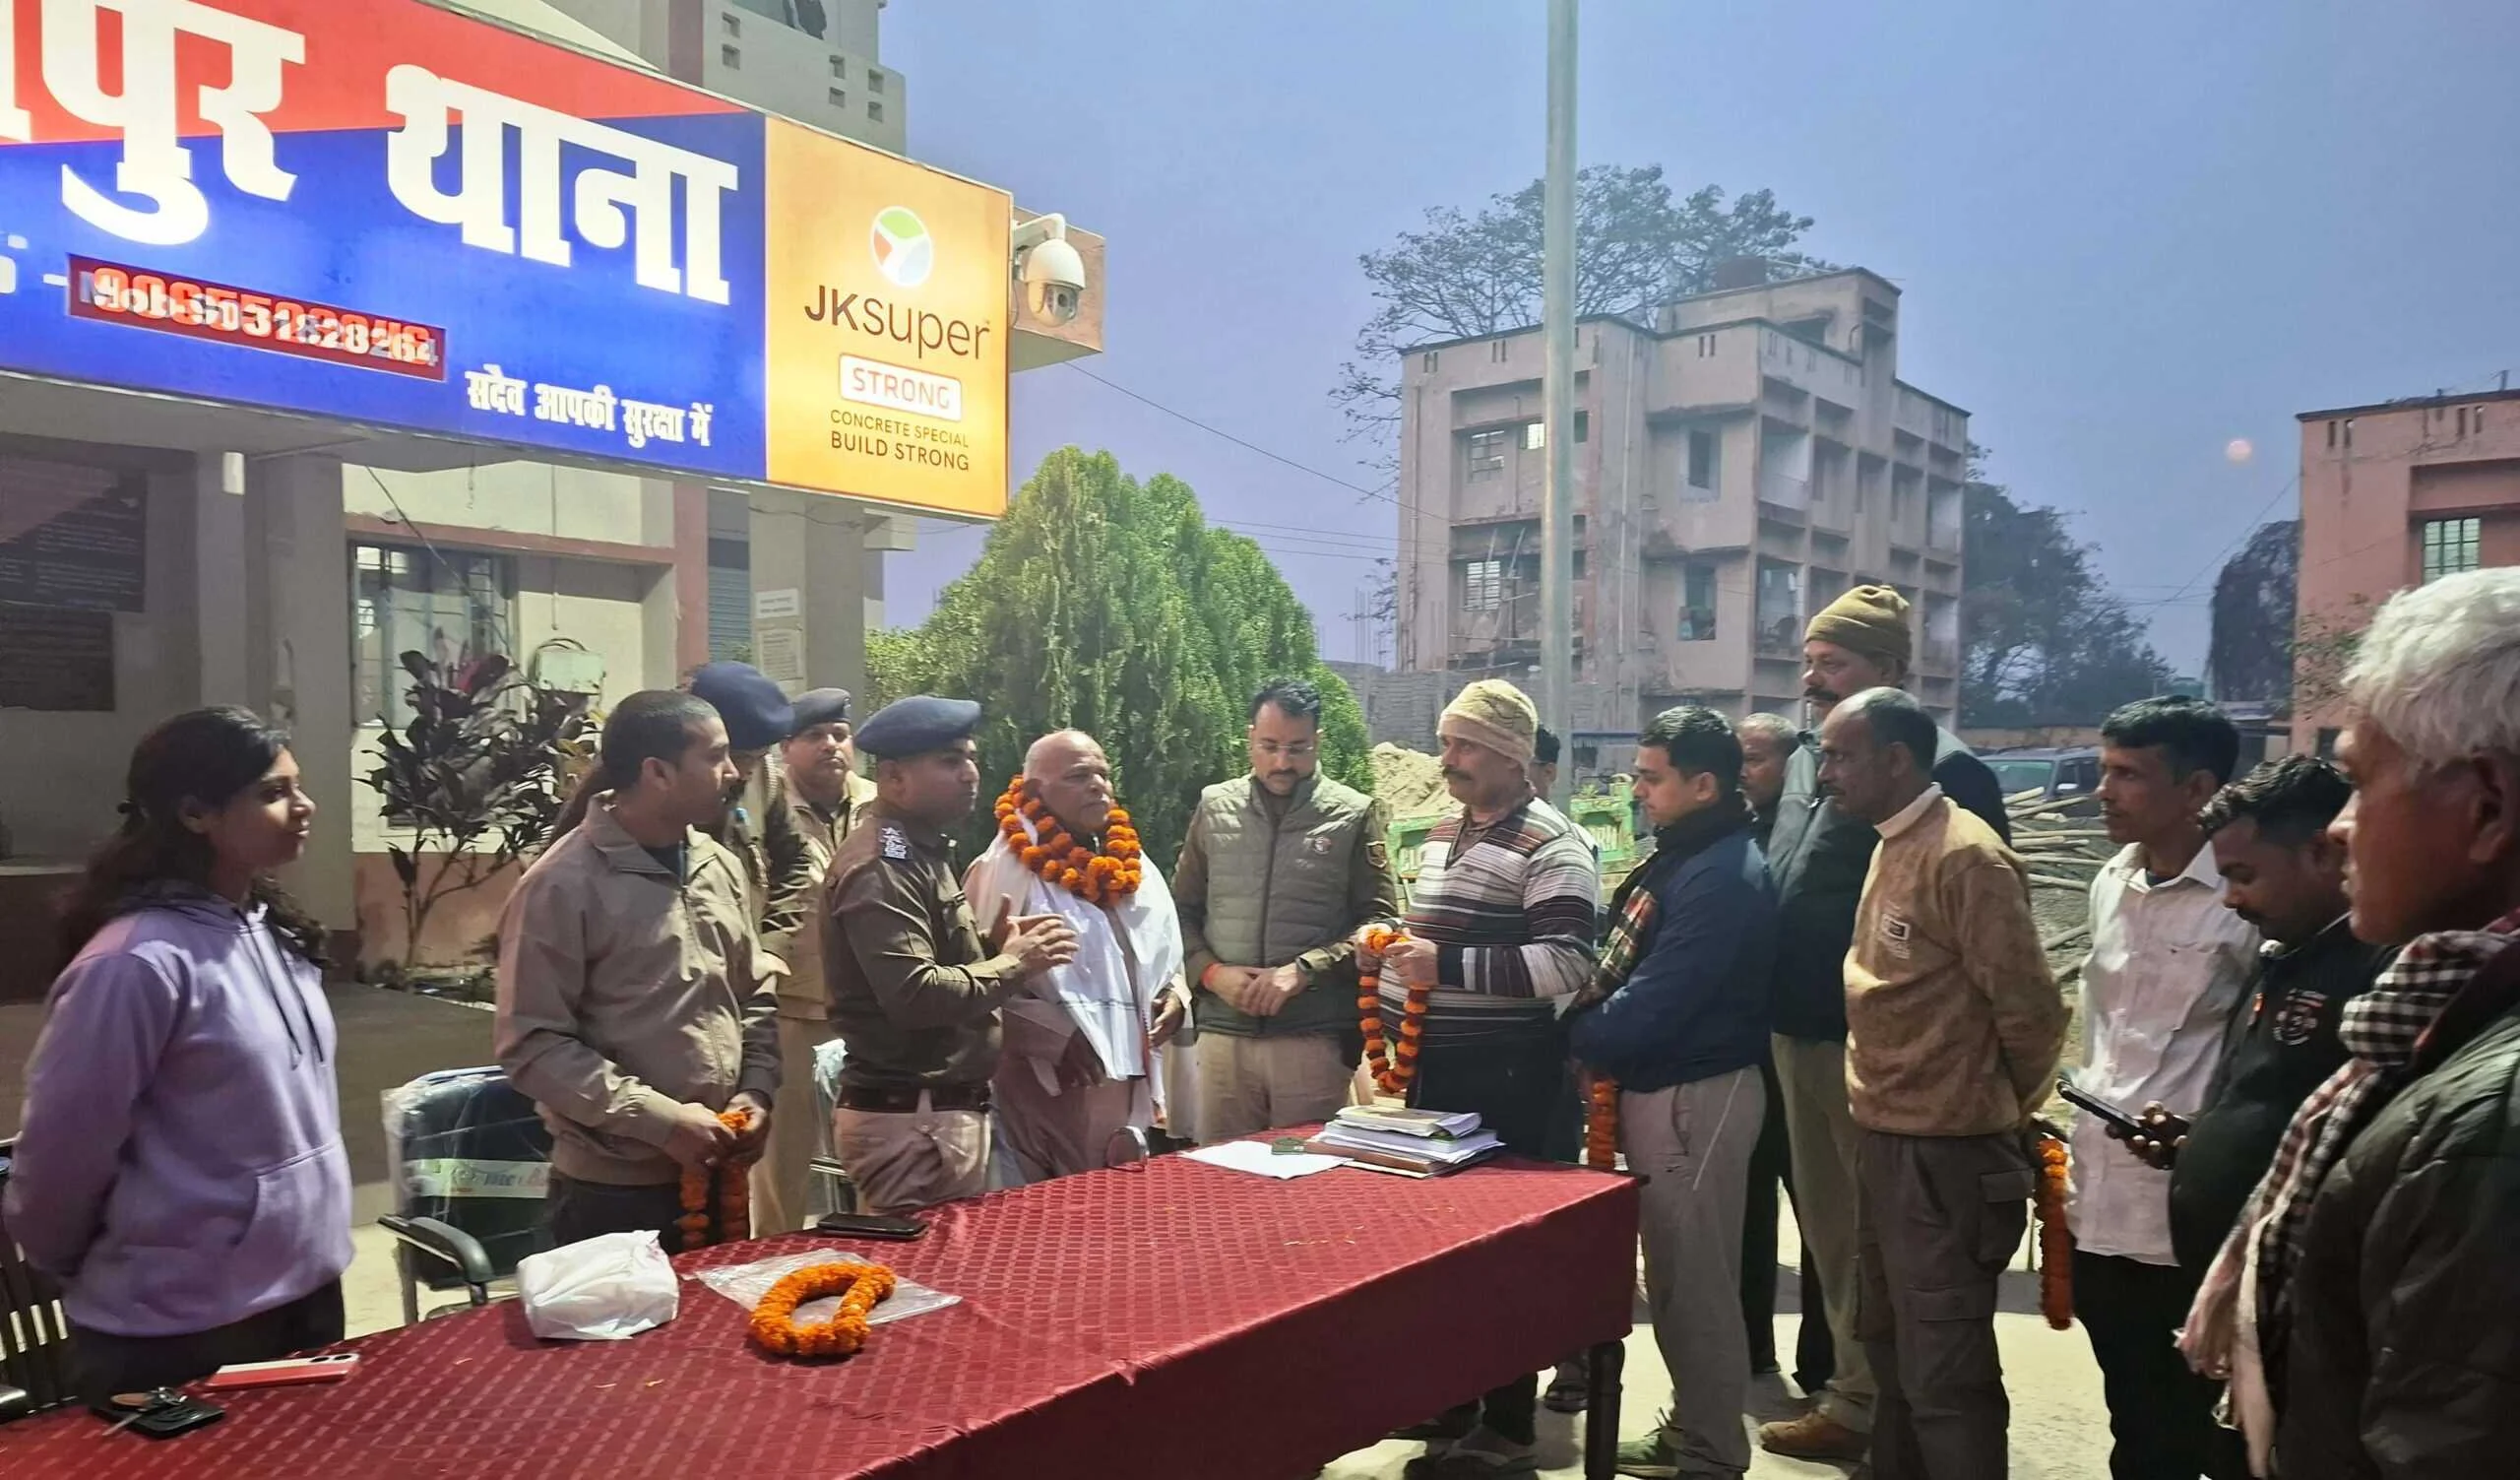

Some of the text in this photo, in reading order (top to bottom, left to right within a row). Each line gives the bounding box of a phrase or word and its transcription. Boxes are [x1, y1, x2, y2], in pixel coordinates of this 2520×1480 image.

[0, 0, 739, 305] पुर थाना
[852, 367, 950, 410] STRONG
[535, 384, 618, 431] आपकी
[621, 399, 685, 449] सुरक्षा
[689, 403, 714, 446] में
[831, 410, 970, 448] CONCRETE SPECIAL
[831, 431, 970, 471] BUILD STRONG
